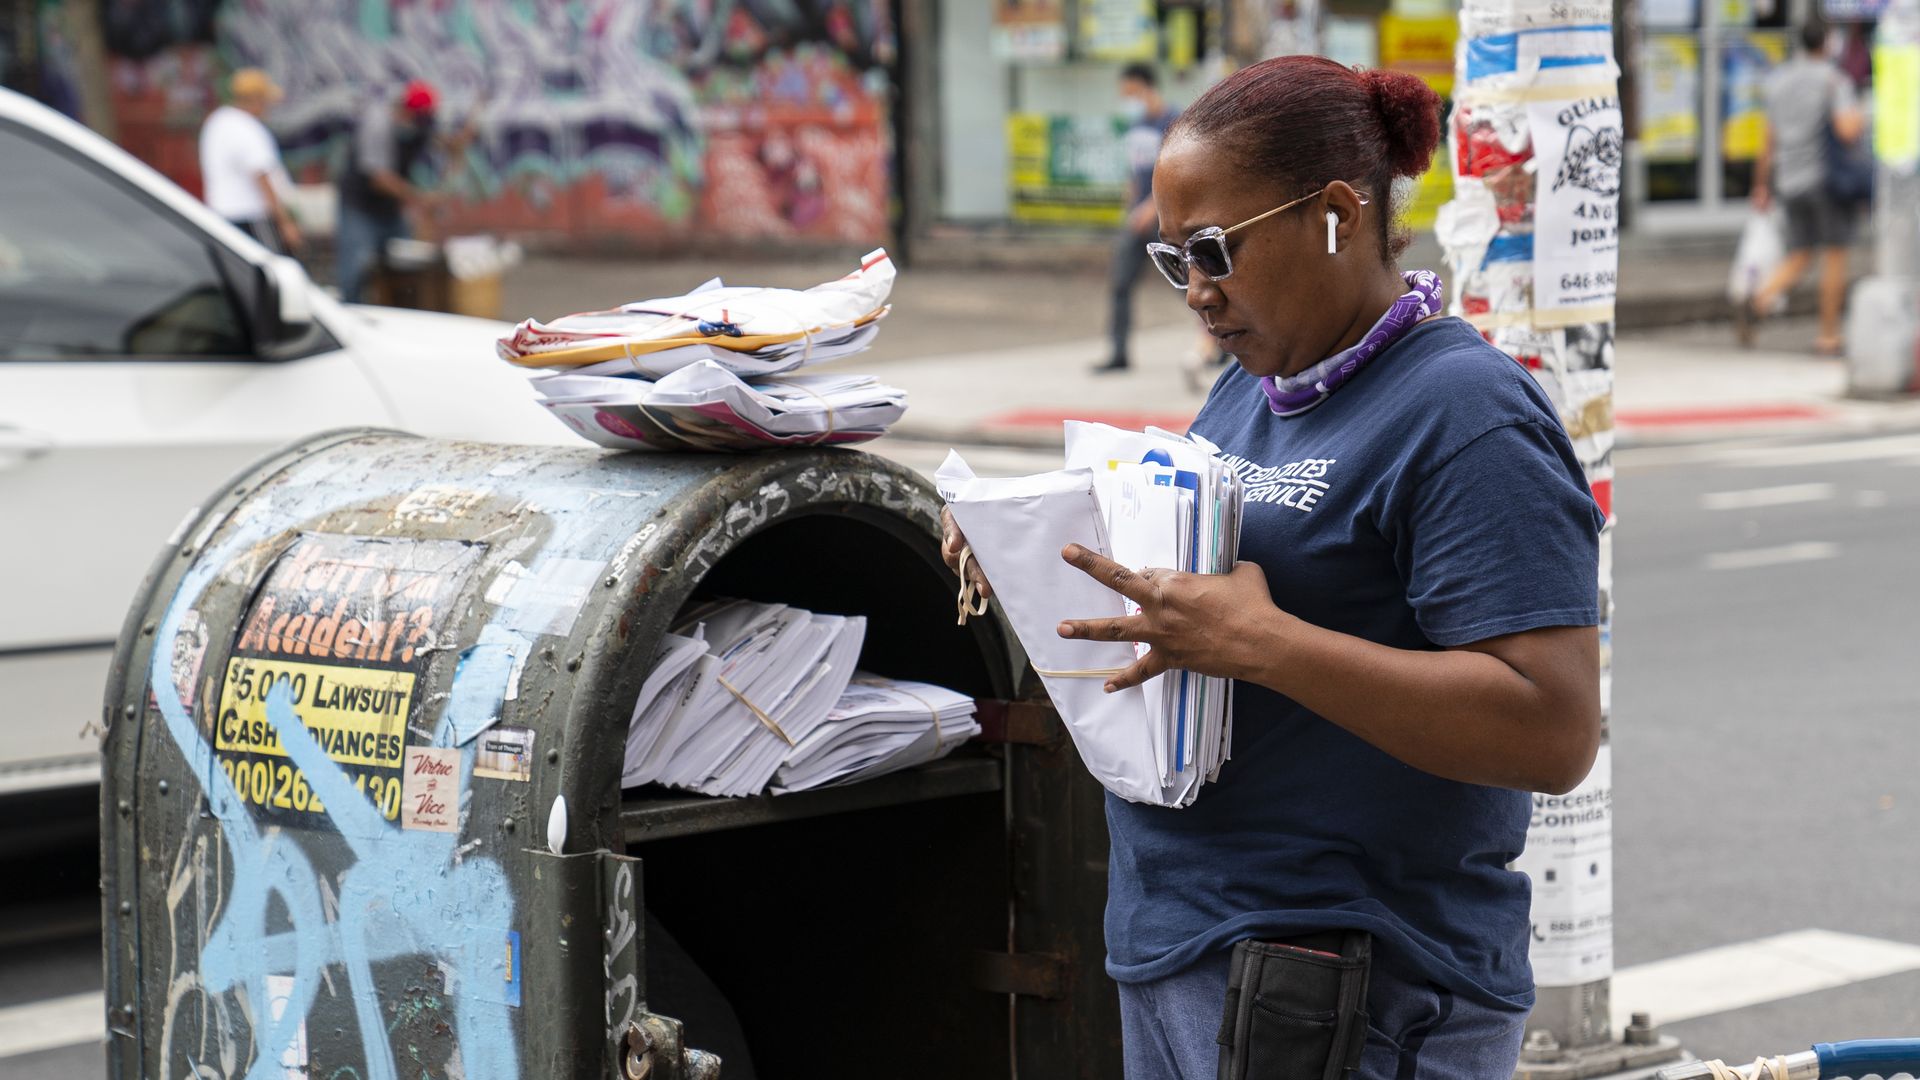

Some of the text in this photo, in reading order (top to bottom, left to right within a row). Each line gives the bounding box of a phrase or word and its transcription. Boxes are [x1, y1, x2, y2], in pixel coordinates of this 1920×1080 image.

[1571, 227, 1606, 247] JOIN
[1275, 458, 1336, 479] STATES
[238, 595, 433, 663] Accident?
[294, 714, 401, 761] DVANCES
[412, 754, 453, 776] Virtue
[414, 793, 446, 815] Vice
